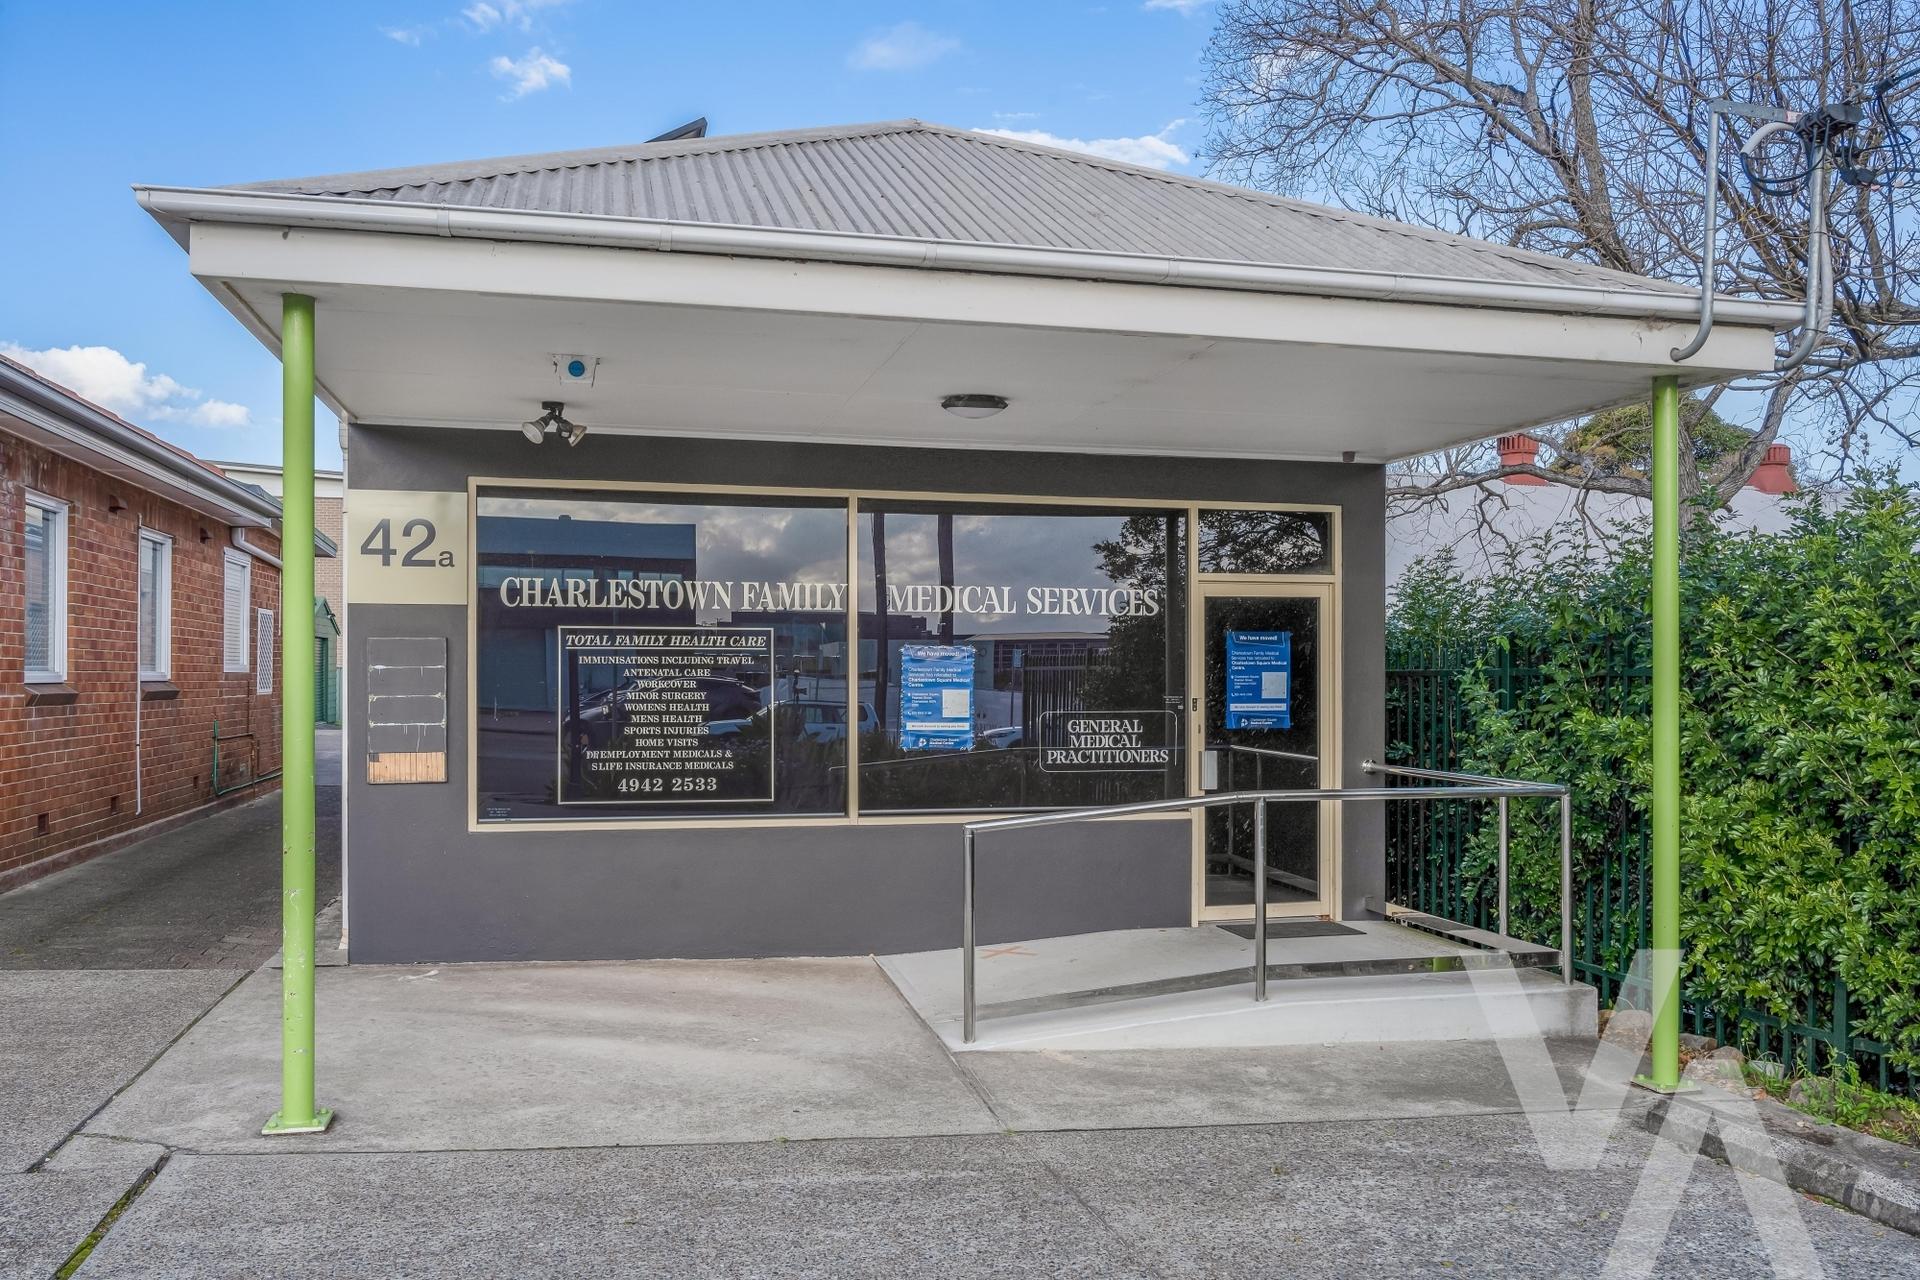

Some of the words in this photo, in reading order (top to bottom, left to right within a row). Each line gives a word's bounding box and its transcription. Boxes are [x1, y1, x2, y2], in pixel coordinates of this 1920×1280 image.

[361, 518, 455, 568] 42a
[500, 576, 733, 609] CHARLESTOWN
[740, 581, 848, 613] FAMILY
[886, 585, 1016, 614] MEDICAL
[1026, 586, 1160, 617] SERVICES
[566, 634, 611, 646] TOTAL
[614, 635, 666, 646] FAMILY
[669, 635, 728, 647] HEALTH
[730, 635, 767, 647] CARE
[578, 656, 659, 664] IMMUNISATIONS
[661, 656, 714, 664] INCLUDING
[717, 656, 754, 664] TRAVEL
[623, 669, 682, 677] ANTENATAL
[684, 669, 711, 677] CARE
[637, 680, 696, 689] WORKCOVER
[626, 692, 659, 700] MINOR
[661, 692, 707, 700] SURGERY
[624, 703, 667, 711] WOMENS
[669, 703, 710, 711] HEALTH
[631, 715, 660, 723] MENS
[662, 715, 702, 723] HEALTH
[624, 727, 661, 735] SPORTS
[664, 727, 710, 735] INJURIES
[1067, 720, 1143, 733] GENERAL
[635, 738, 664, 747] HOME
[666, 738, 699, 747] VISITS
[1070, 734, 1141, 748] MEDICAL
[673, 750, 722, 758] MEDICALS
[724, 750, 733, 758] &
[1046, 749, 1169, 764] PRACTITIONERS
[625, 762, 682, 770] INSURANCE
[684, 761, 734, 769] MEDICALS
[617, 778, 663, 792] 4942
[672, 777, 717, 791] 2533
